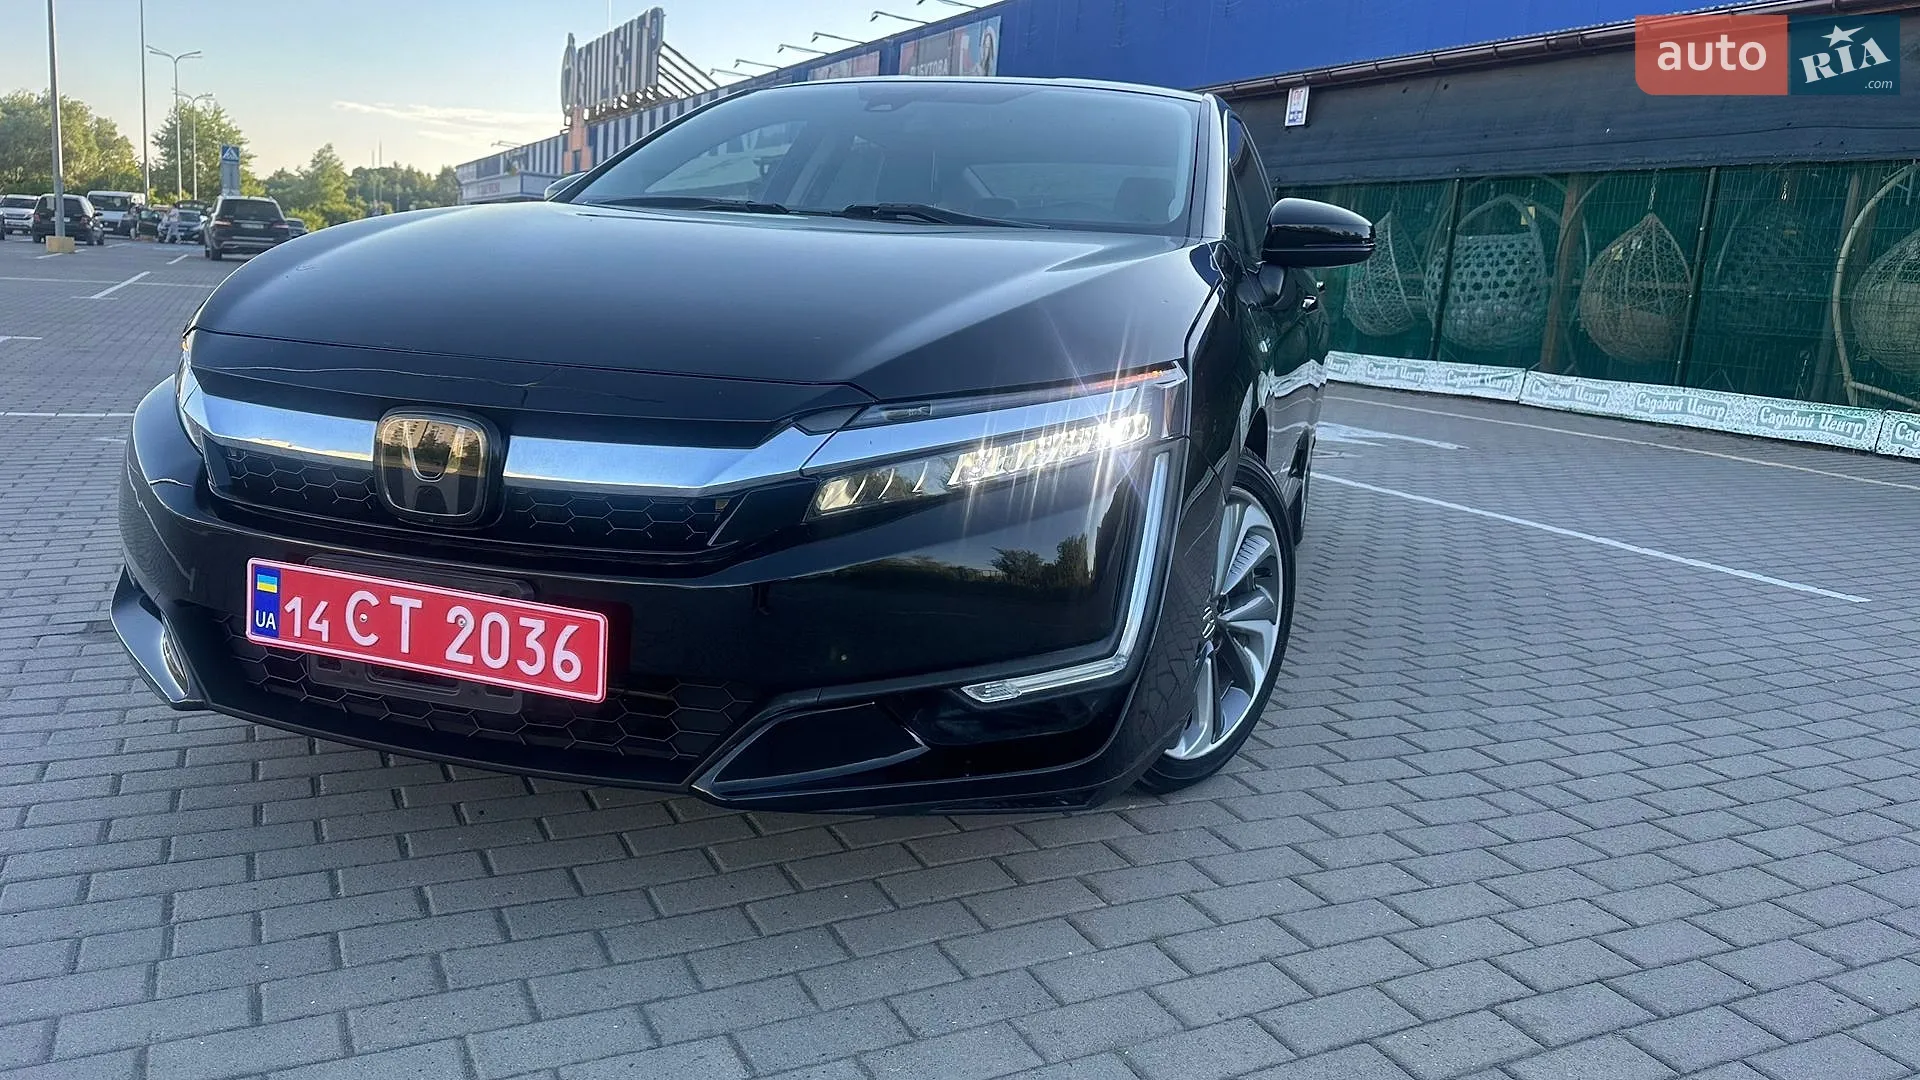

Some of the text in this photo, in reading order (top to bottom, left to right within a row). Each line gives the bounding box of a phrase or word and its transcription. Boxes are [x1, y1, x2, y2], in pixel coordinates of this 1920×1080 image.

[1531, 382, 1608, 406] Садовий Центр
[1636, 392, 1725, 422] Садовий Центр
[1759, 407, 1865, 435] Садовий Центр
[255, 610, 277, 631] UA
[284, 590, 583, 683] 14 CT 2036
